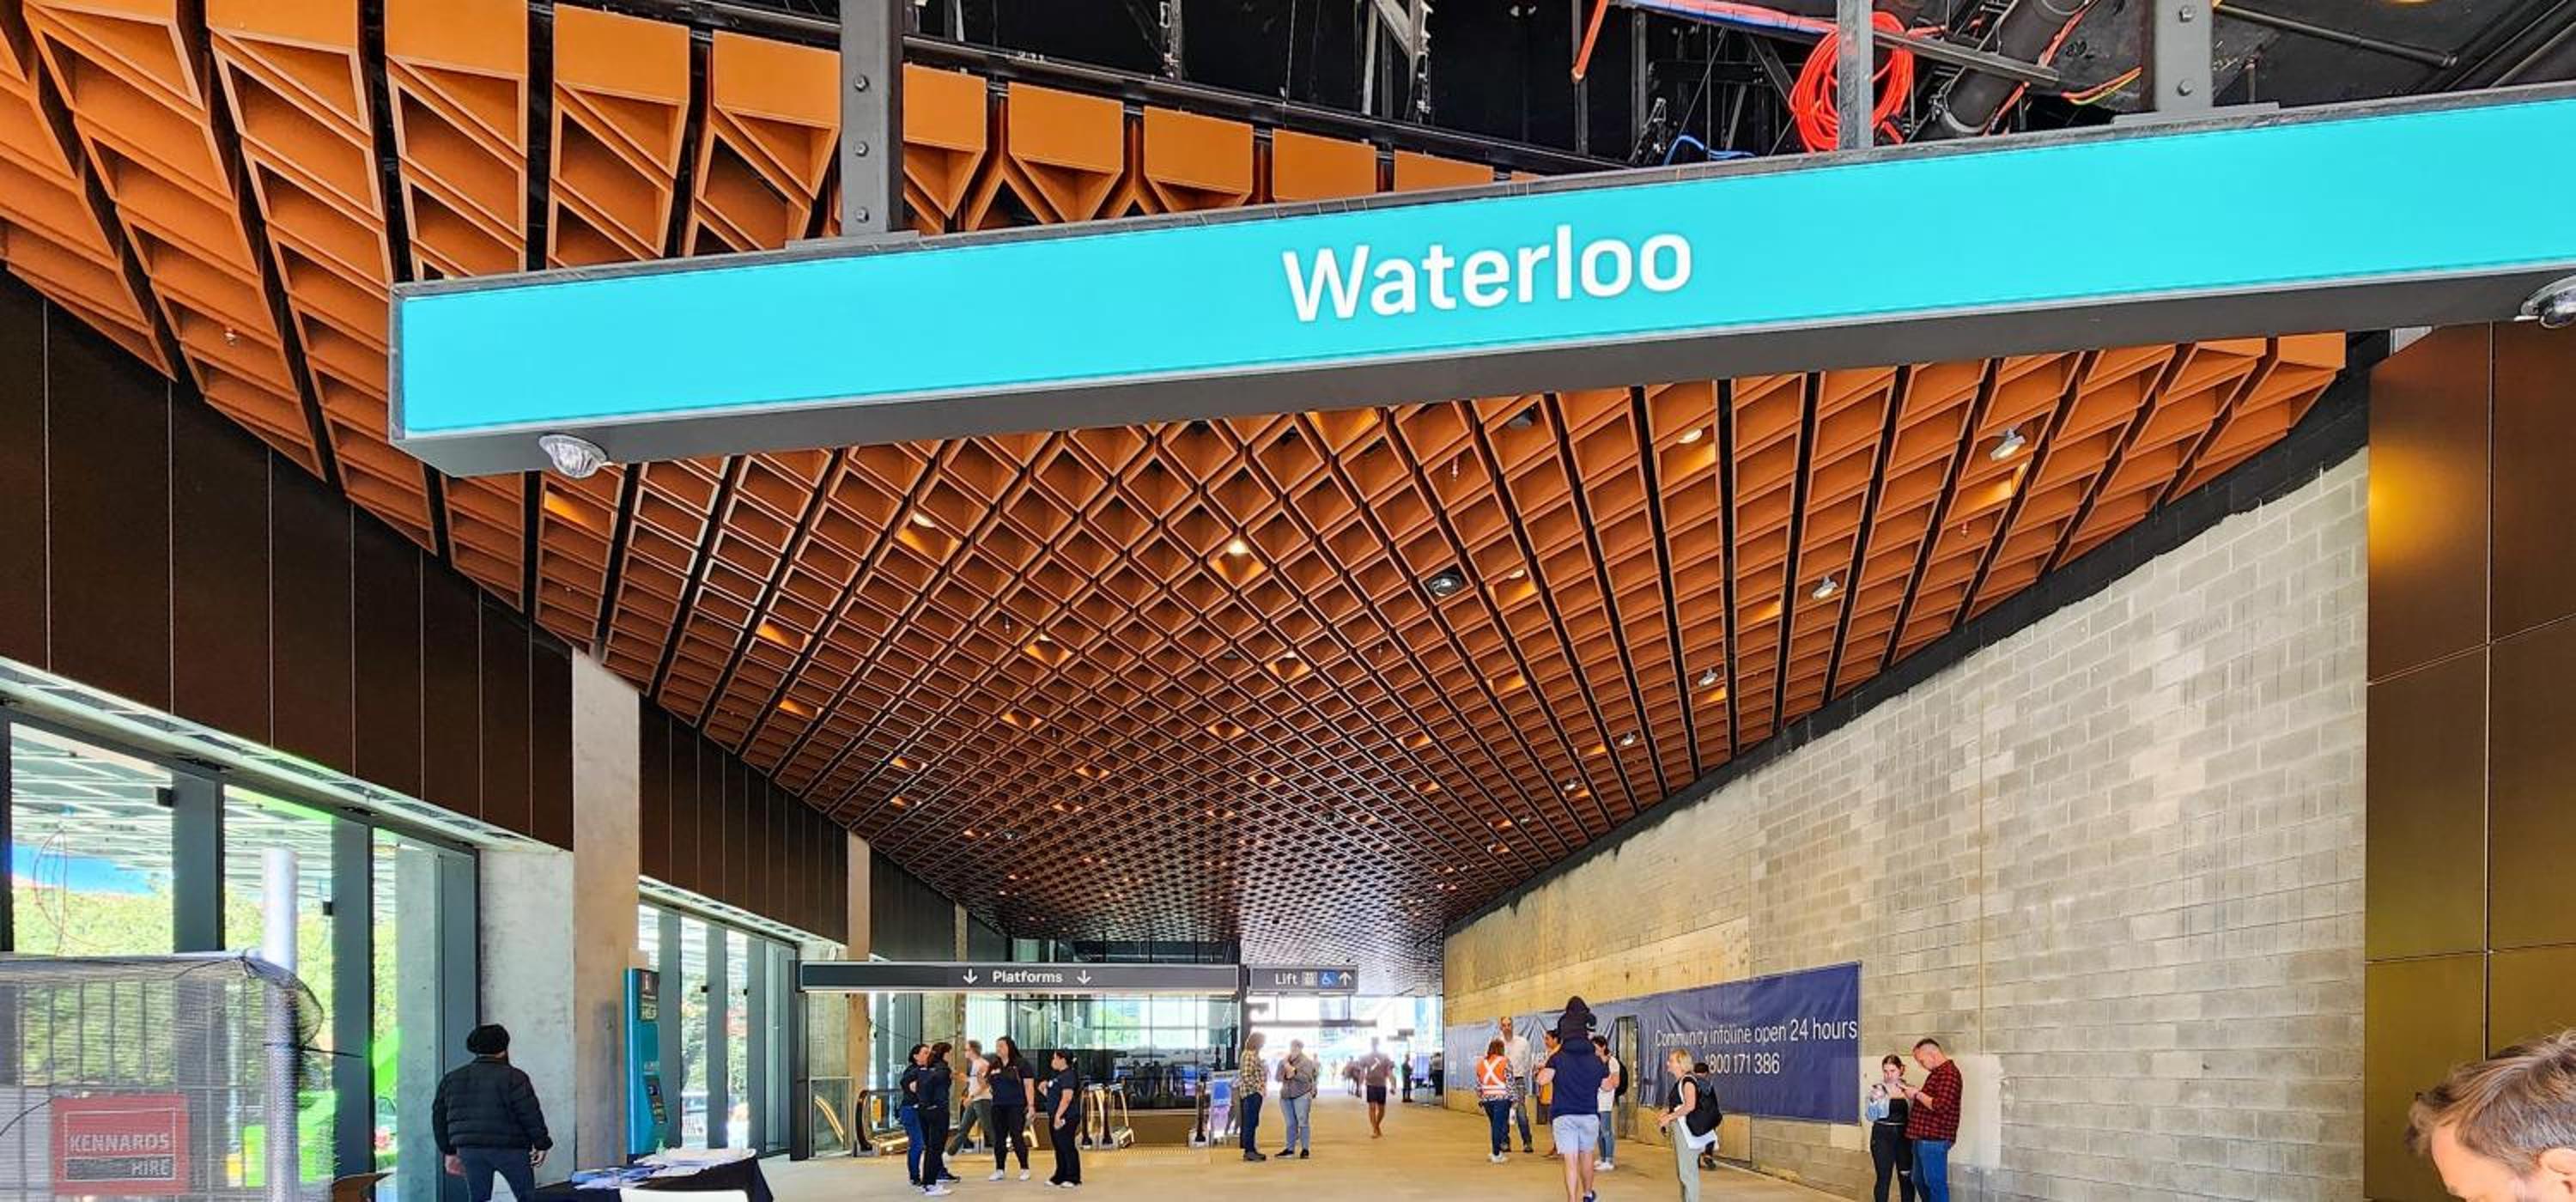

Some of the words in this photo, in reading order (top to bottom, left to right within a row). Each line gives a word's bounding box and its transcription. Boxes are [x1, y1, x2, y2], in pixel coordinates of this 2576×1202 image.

[1282, 223, 1692, 323] Waterloo
[993, 970, 1063, 983] Platforms
[1275, 973, 1297, 985] Lift
[1655, 1029, 1707, 1048] Community
[1709, 1025, 1752, 1045] infoline
[1754, 1025, 1787, 1043] open
[1790, 1018, 1808, 1041] 24
[1813, 1017, 1857, 1040] hours
[1733, 1054, 1751, 1073] 171
[1754, 1053, 1780, 1074] 386
[69, 1132, 170, 1152] KENNARDS
[131, 1158, 171, 1176] HIRE
